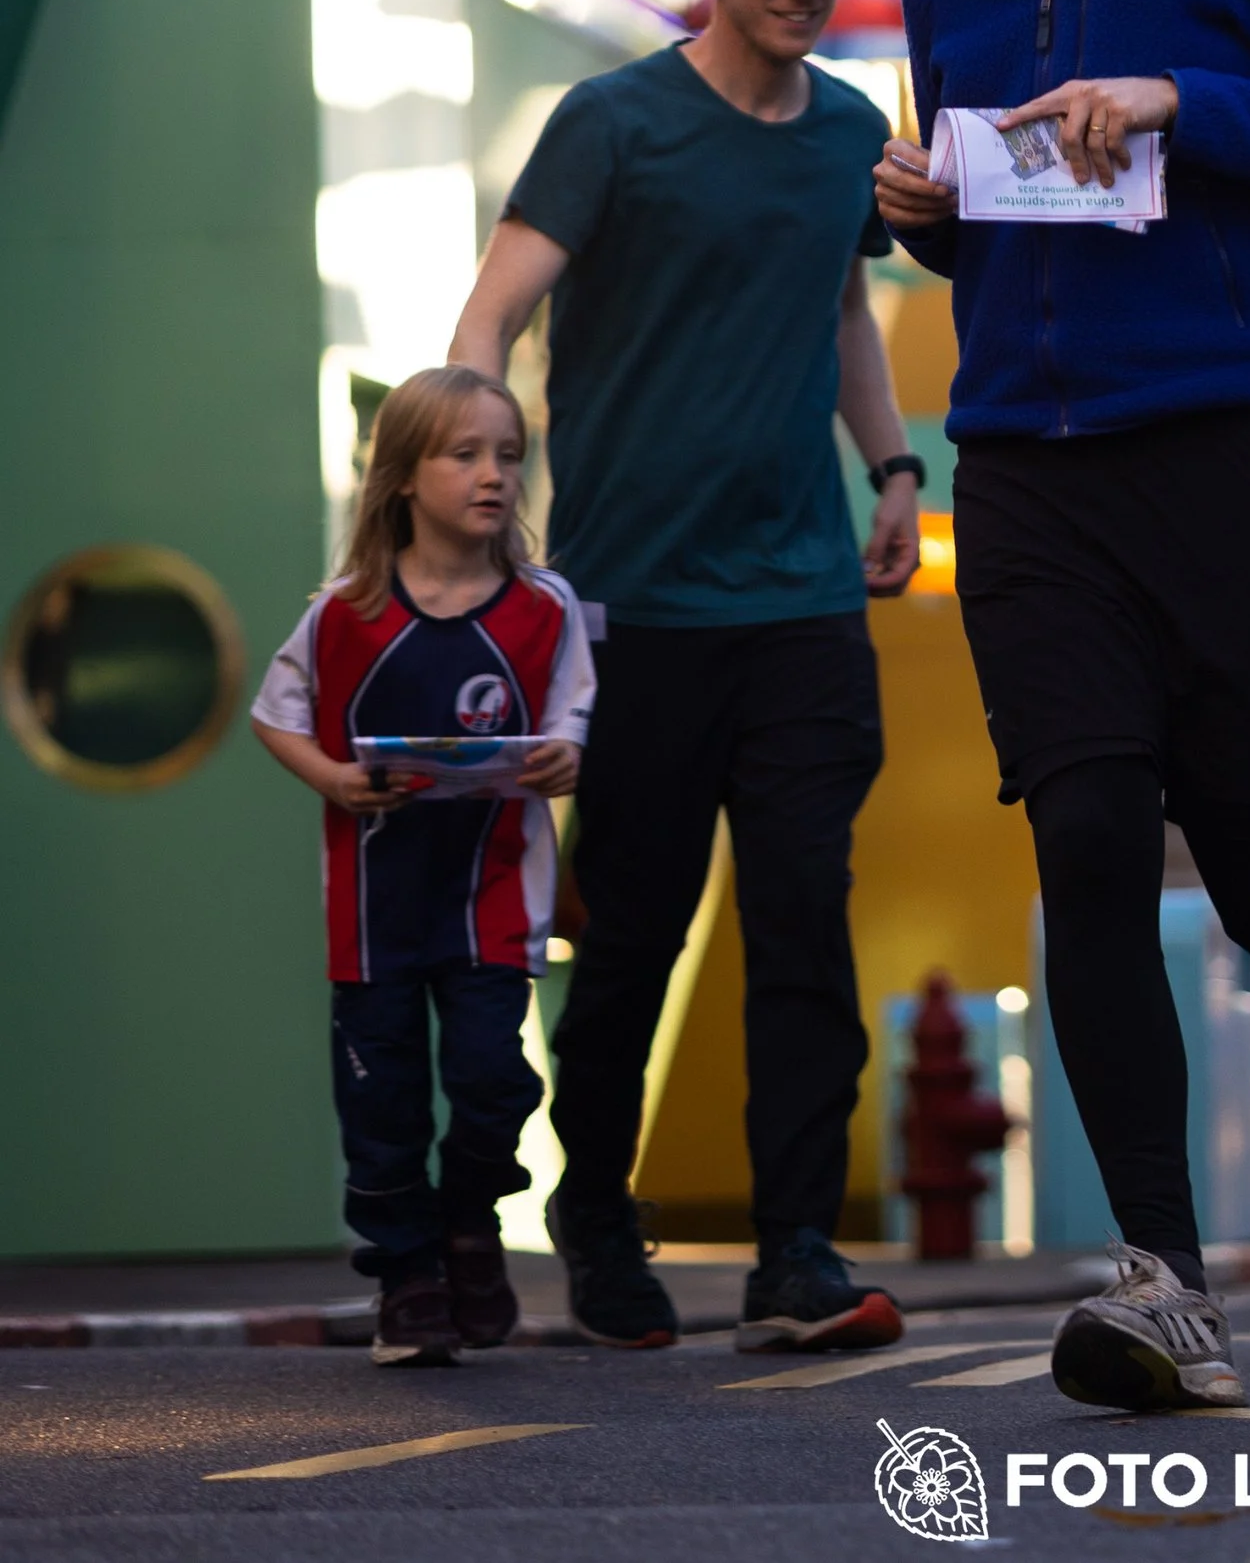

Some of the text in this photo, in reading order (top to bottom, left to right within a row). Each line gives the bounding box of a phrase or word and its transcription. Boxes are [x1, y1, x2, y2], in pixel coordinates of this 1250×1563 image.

[1017, 185, 1039, 194] 2025
[1042, 184, 1089, 194] september
[995, 195, 1125, 209] Gröna Lund-sprinten
